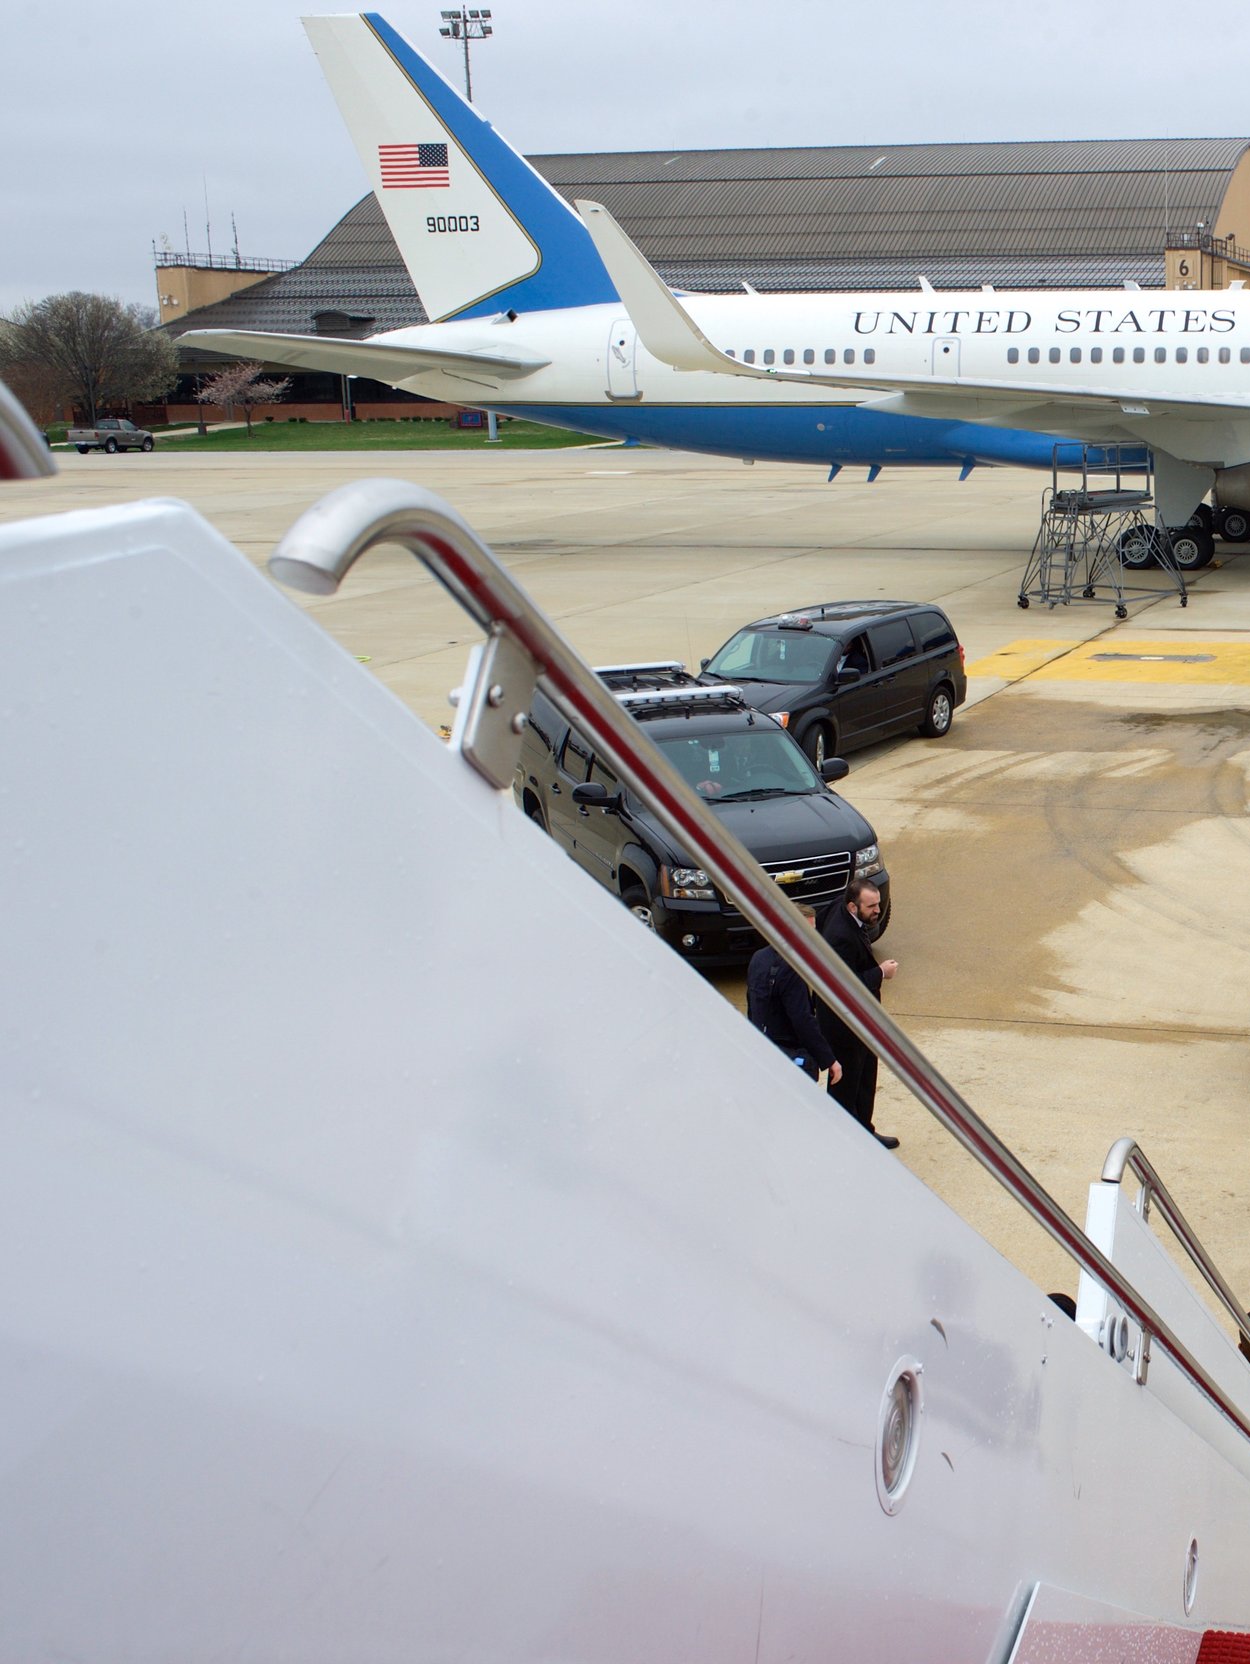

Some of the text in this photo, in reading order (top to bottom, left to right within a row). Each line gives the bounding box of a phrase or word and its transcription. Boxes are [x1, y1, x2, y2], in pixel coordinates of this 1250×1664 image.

[426, 215, 480, 233] 90003
[1178, 259, 1190, 277] 6
[853, 310, 1032, 335] UNITED
[1055, 309, 1237, 333] STATES
